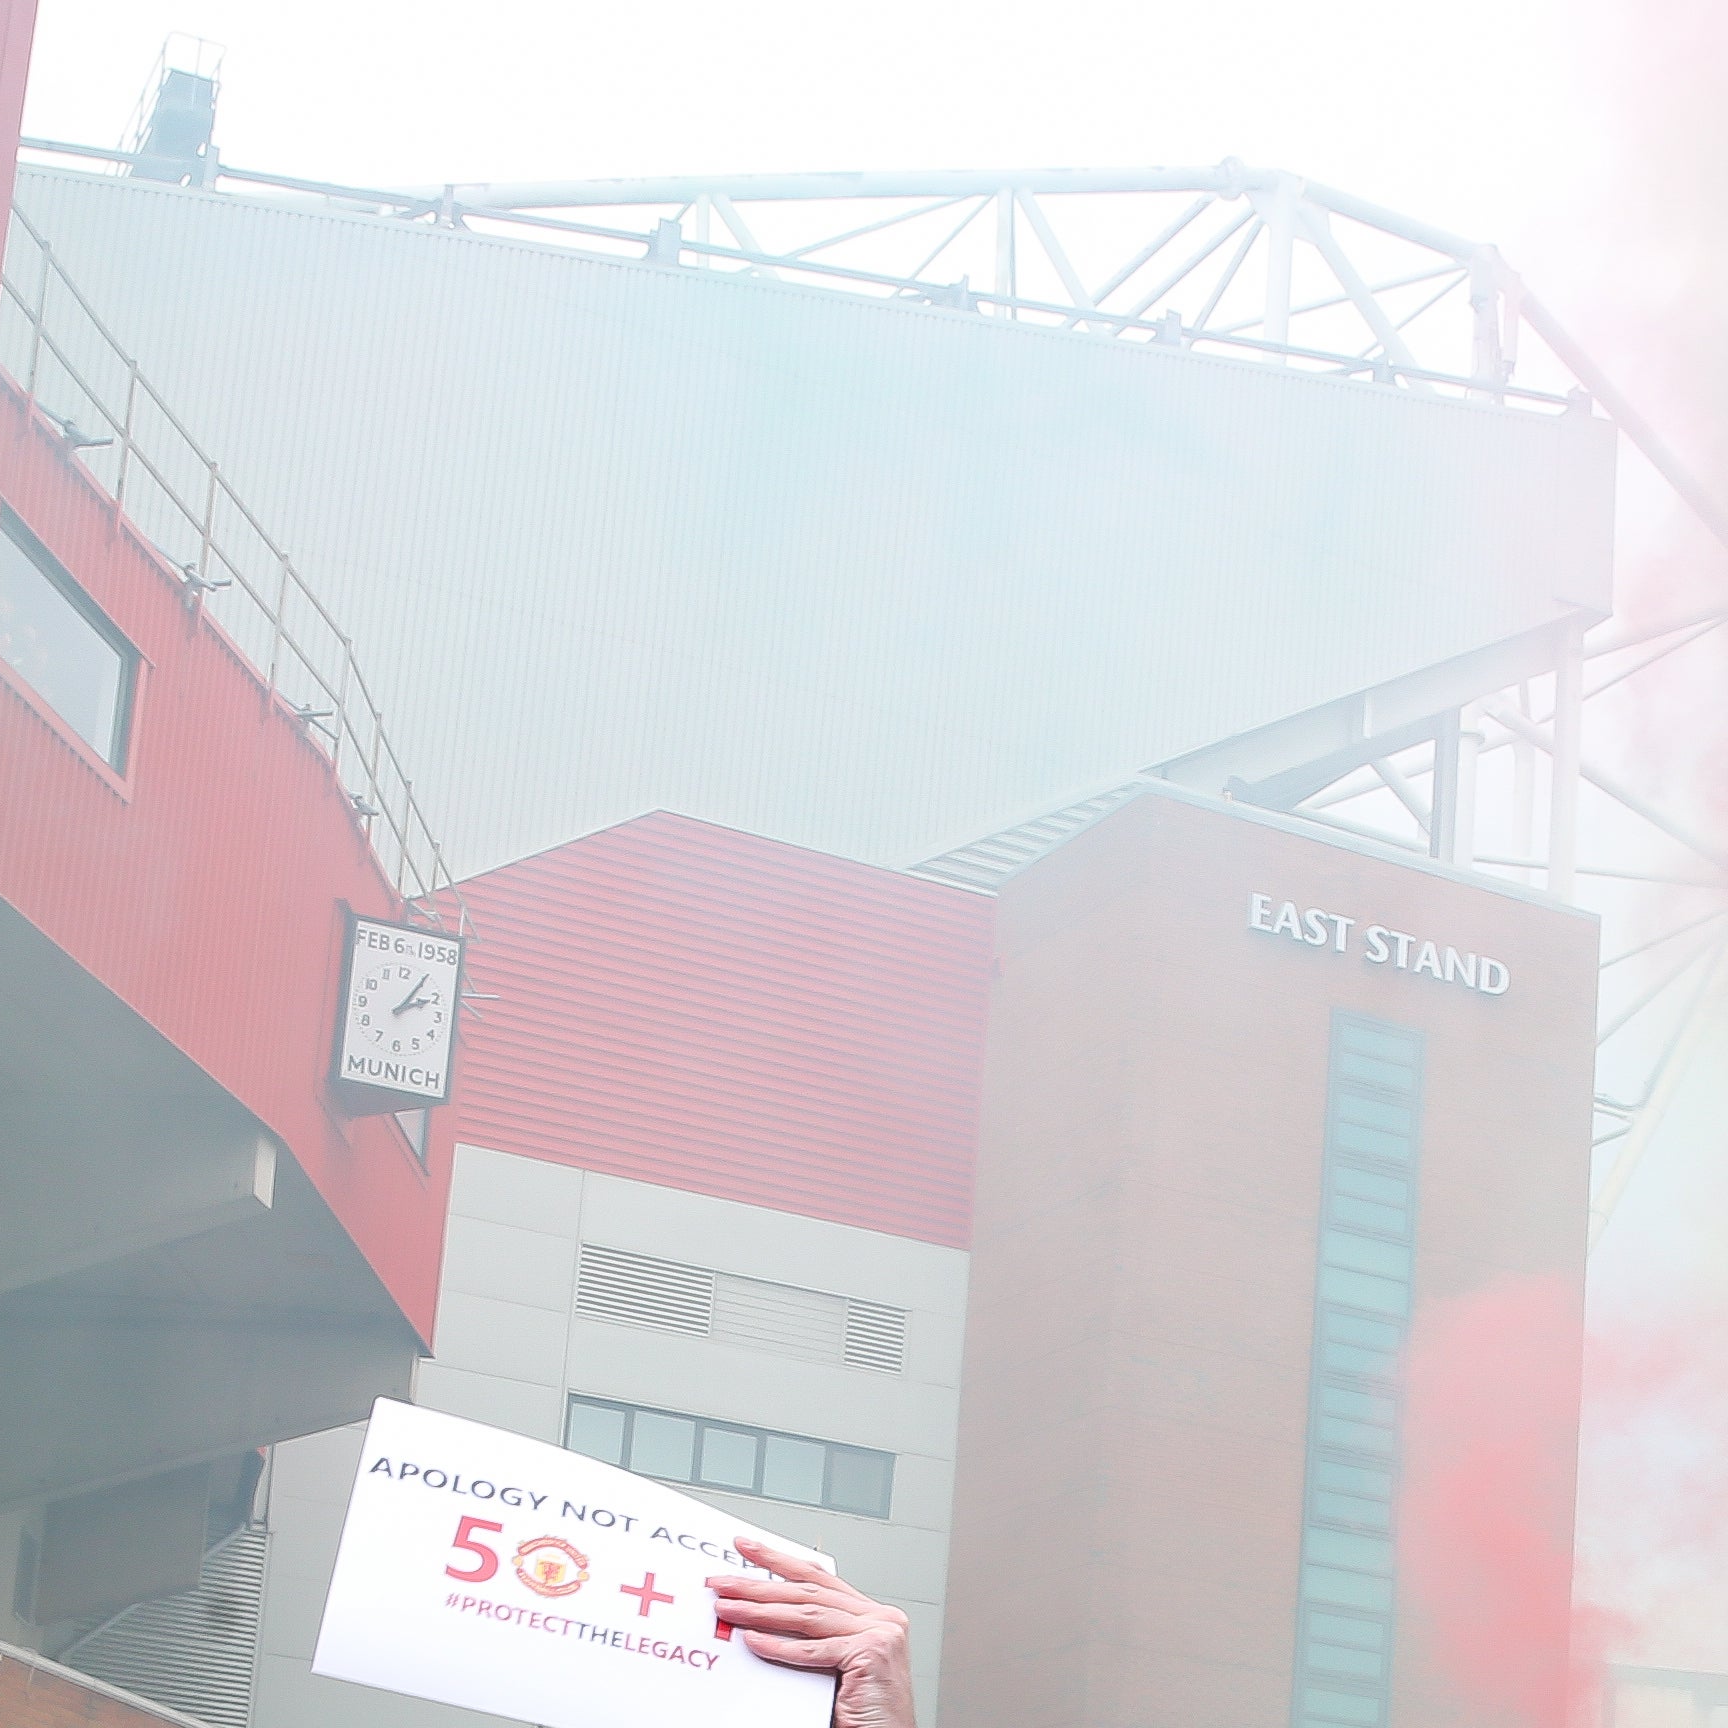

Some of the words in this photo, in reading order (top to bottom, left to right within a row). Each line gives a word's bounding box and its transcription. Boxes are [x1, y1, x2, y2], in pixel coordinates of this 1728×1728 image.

[357, 929, 390, 952] FEB
[417, 942, 459, 966] 1958
[1247, 889, 1356, 953] EAST
[1363, 923, 1512, 997] STAND
[397, 966, 412, 980] 12
[365, 978, 379, 991] 10
[357, 995, 368, 1008] 9
[429, 991, 441, 1006] 2
[360, 1014, 371, 1027] 8
[432, 1011, 443, 1025] 3
[374, 1030, 384, 1043] 7
[426, 1029, 435, 1041] 4
[391, 1039, 401, 1053] 6
[410, 1037, 421, 1051] 5
[347, 1054, 440, 1090] MUNICH
[369, 1456, 548, 1511] APOLOGY
[560, 1499, 639, 1533] NOT
[649, 1526, 774, 1581] ACCE
[444, 1593, 722, 1672] #PROTECTTHELEGACY
